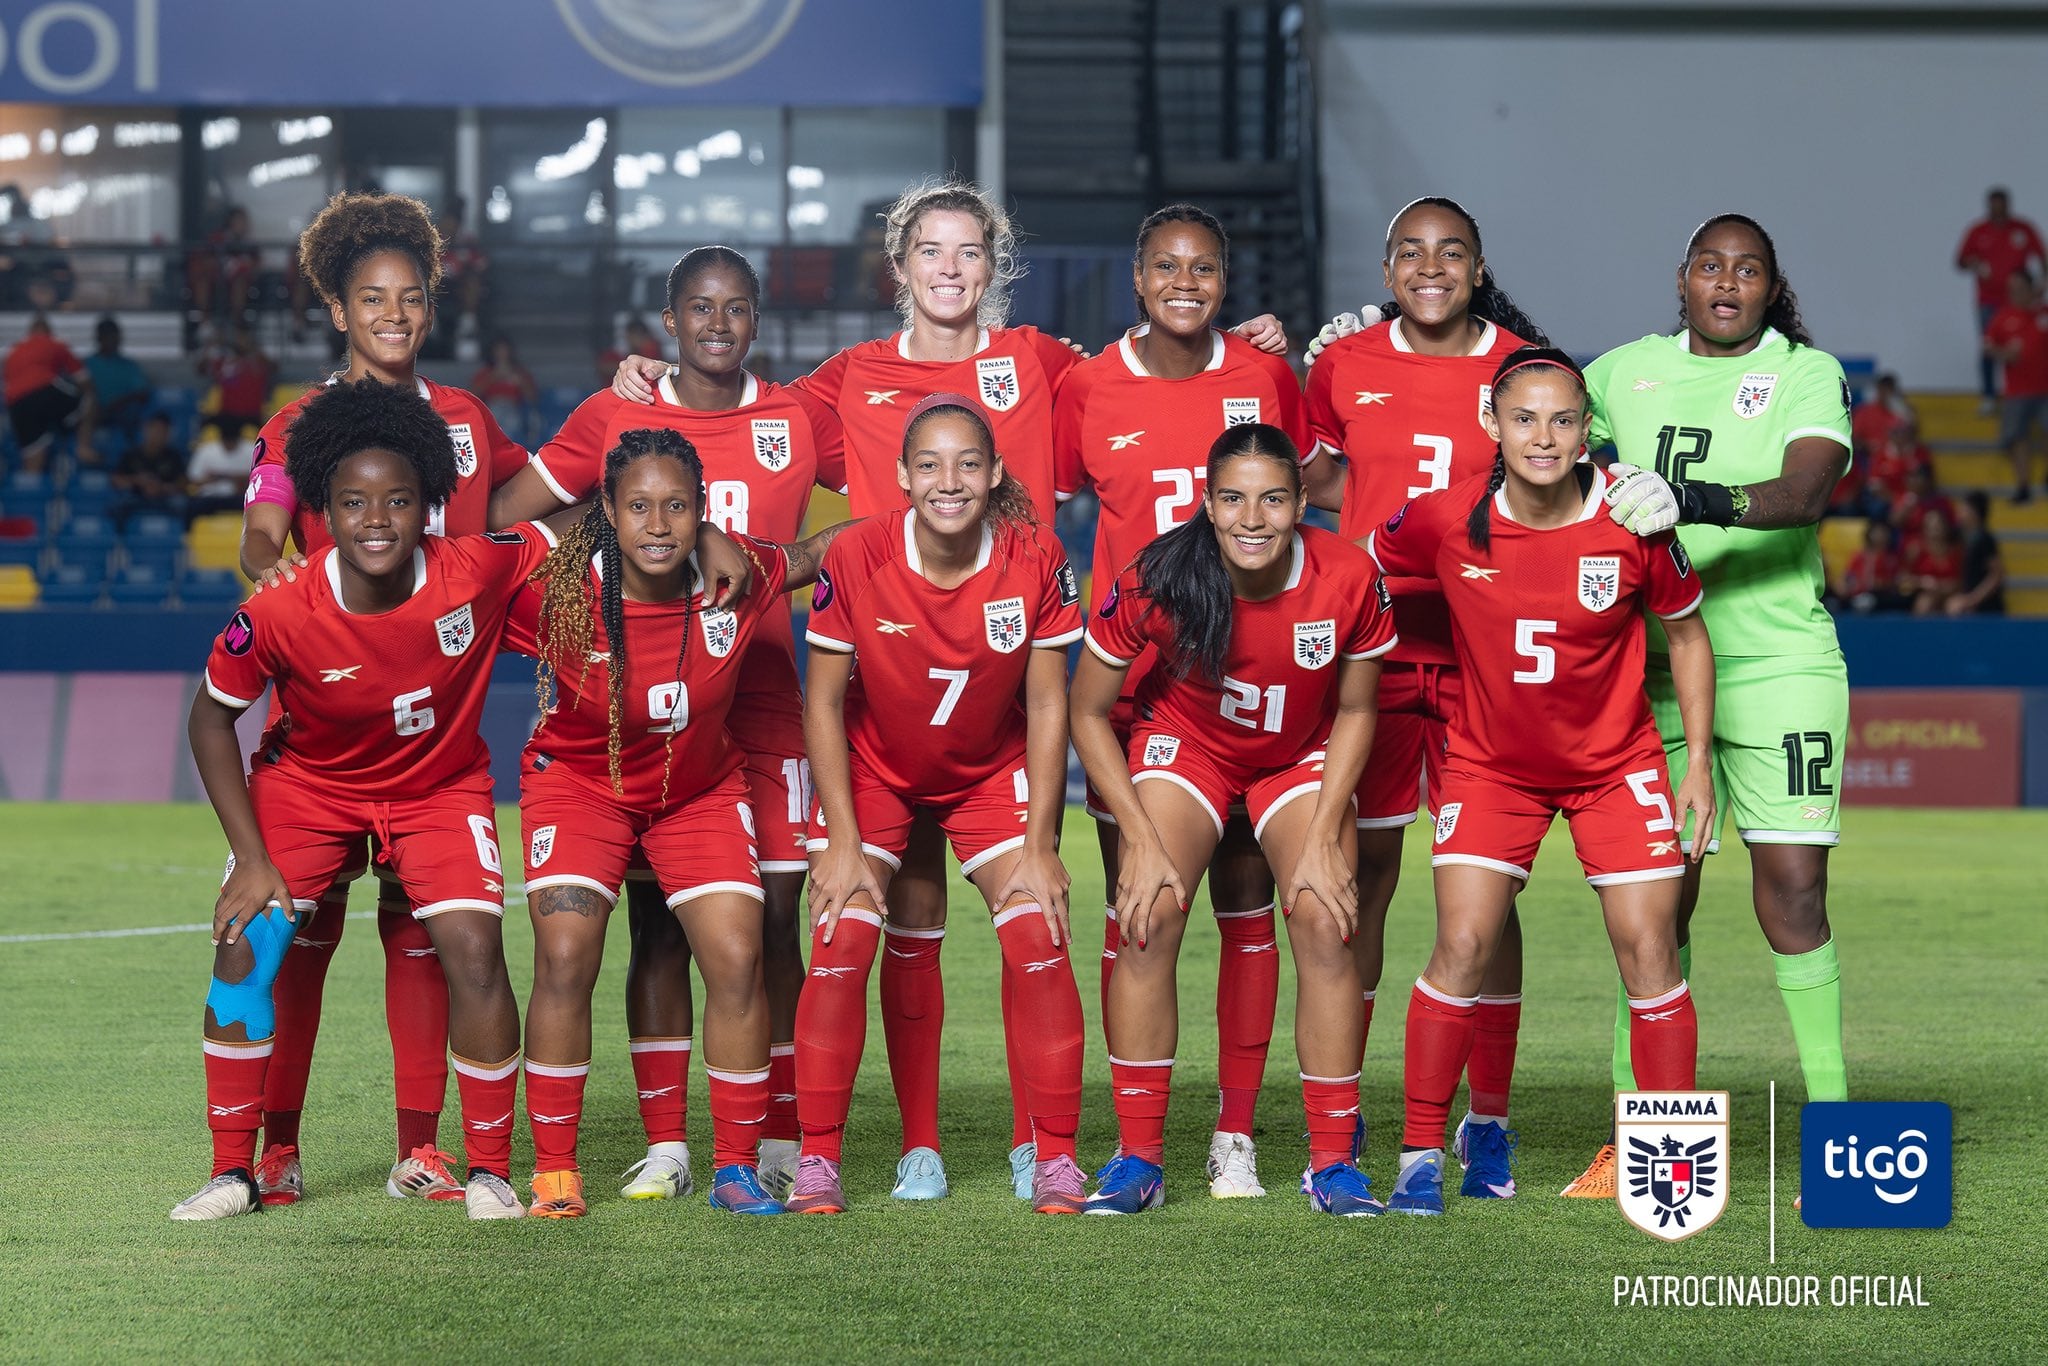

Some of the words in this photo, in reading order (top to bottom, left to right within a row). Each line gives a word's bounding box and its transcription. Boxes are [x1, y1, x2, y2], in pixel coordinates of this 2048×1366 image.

[1407, 433, 1453, 499] 3
[1655, 424, 1712, 485] 12
[701, 480, 750, 536] 8
[1152, 466, 1208, 535] 2
[1513, 618, 1557, 684] 5
[392, 685, 436, 736] 6
[647, 680, 690, 734] 9
[928, 667, 970, 726] 7
[1219, 674, 1287, 734] 21
[1781, 731, 1833, 797] 12
[1862, 720, 1986, 749] OFICIAL
[1624, 768, 1674, 834] 5
[466, 813, 503, 876] 6
